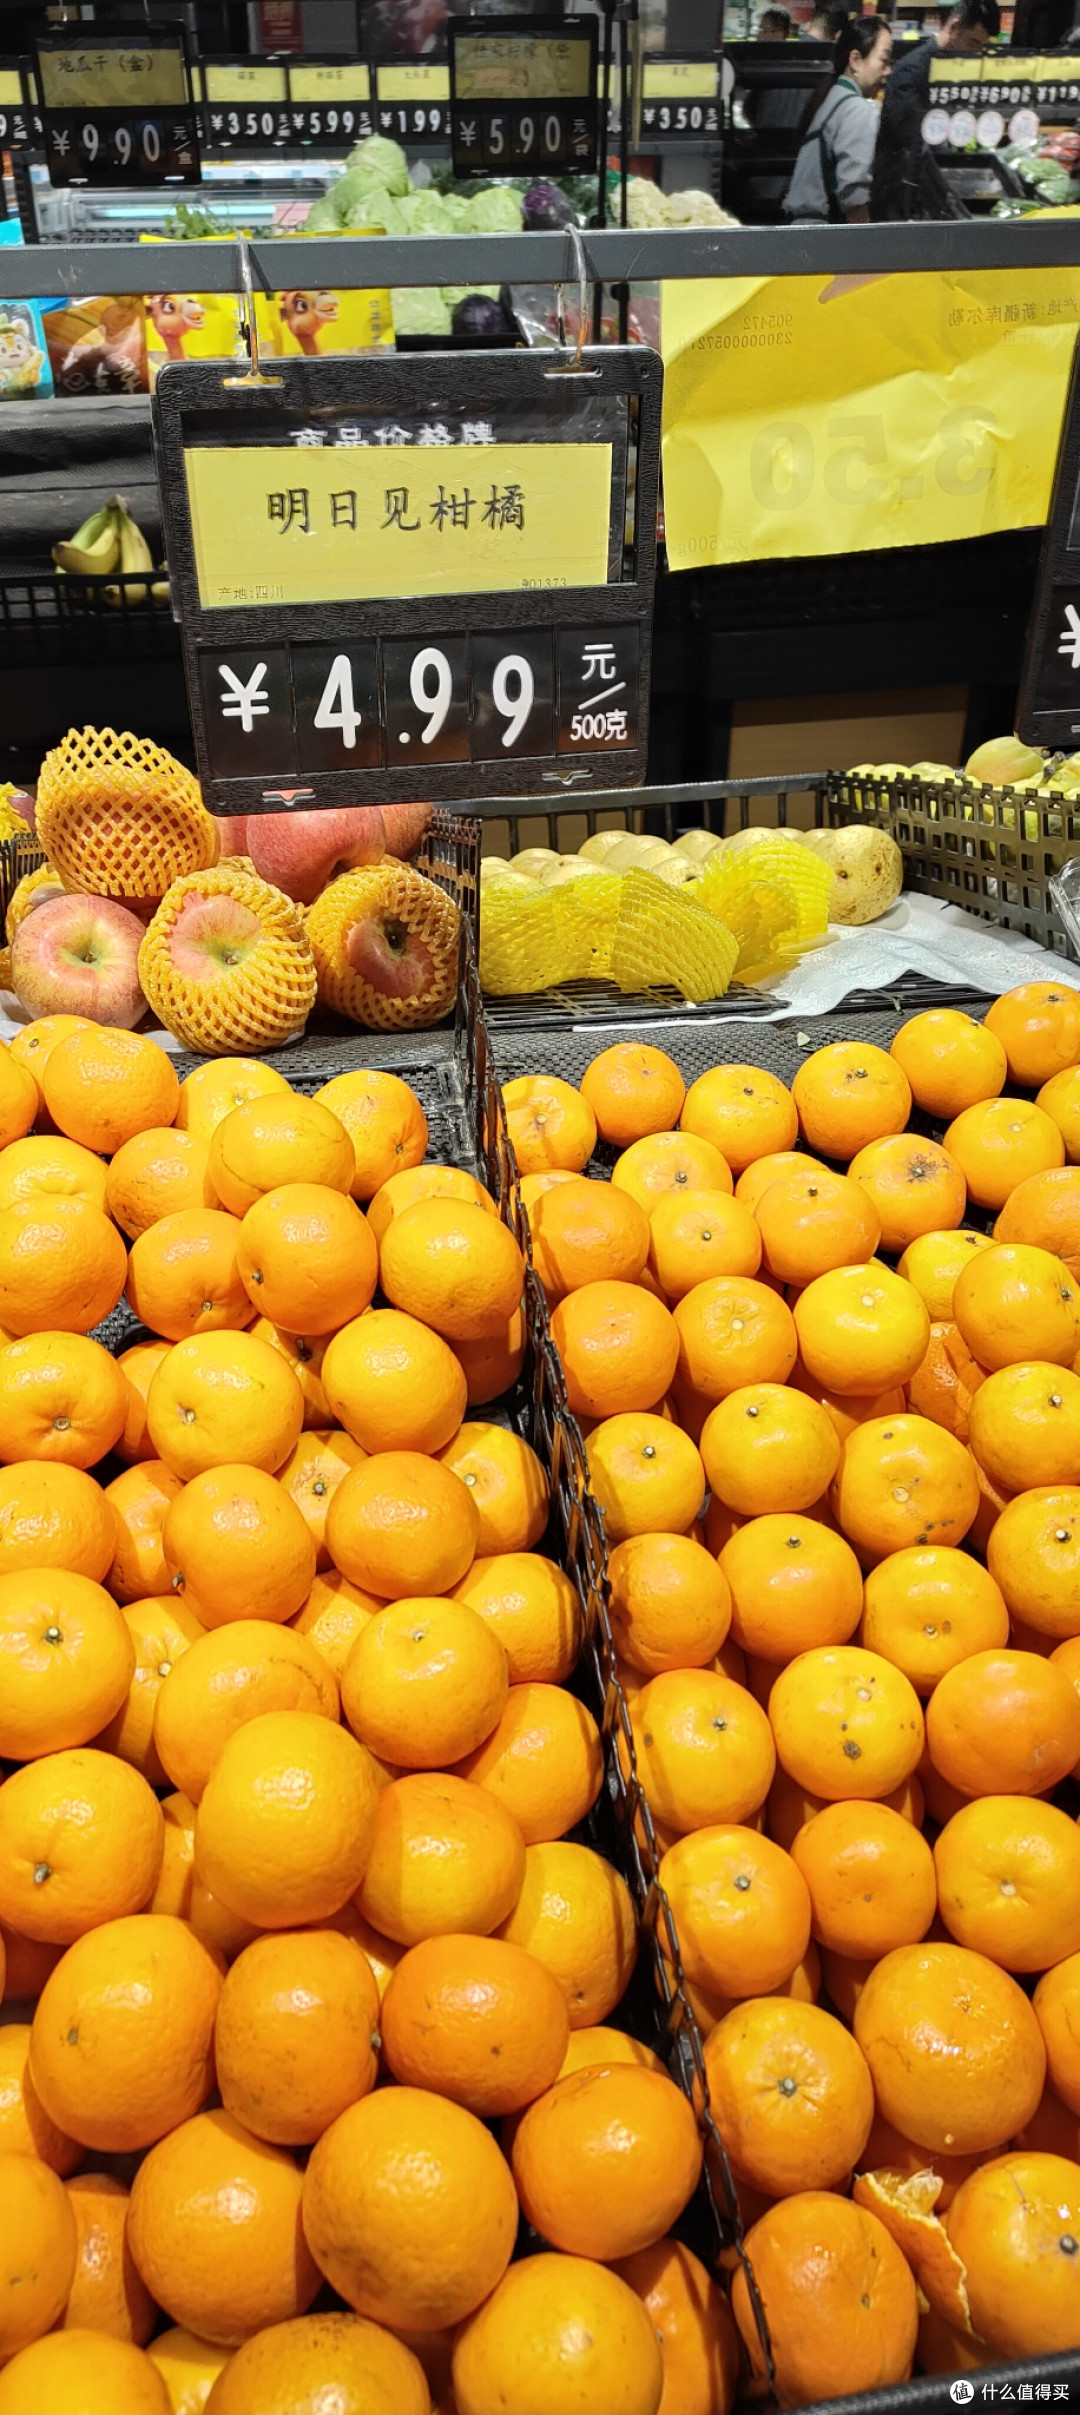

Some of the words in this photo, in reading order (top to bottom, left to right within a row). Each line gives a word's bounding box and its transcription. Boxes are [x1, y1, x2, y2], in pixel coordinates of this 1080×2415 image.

[267, 484, 527, 535] 明日见柑橘
